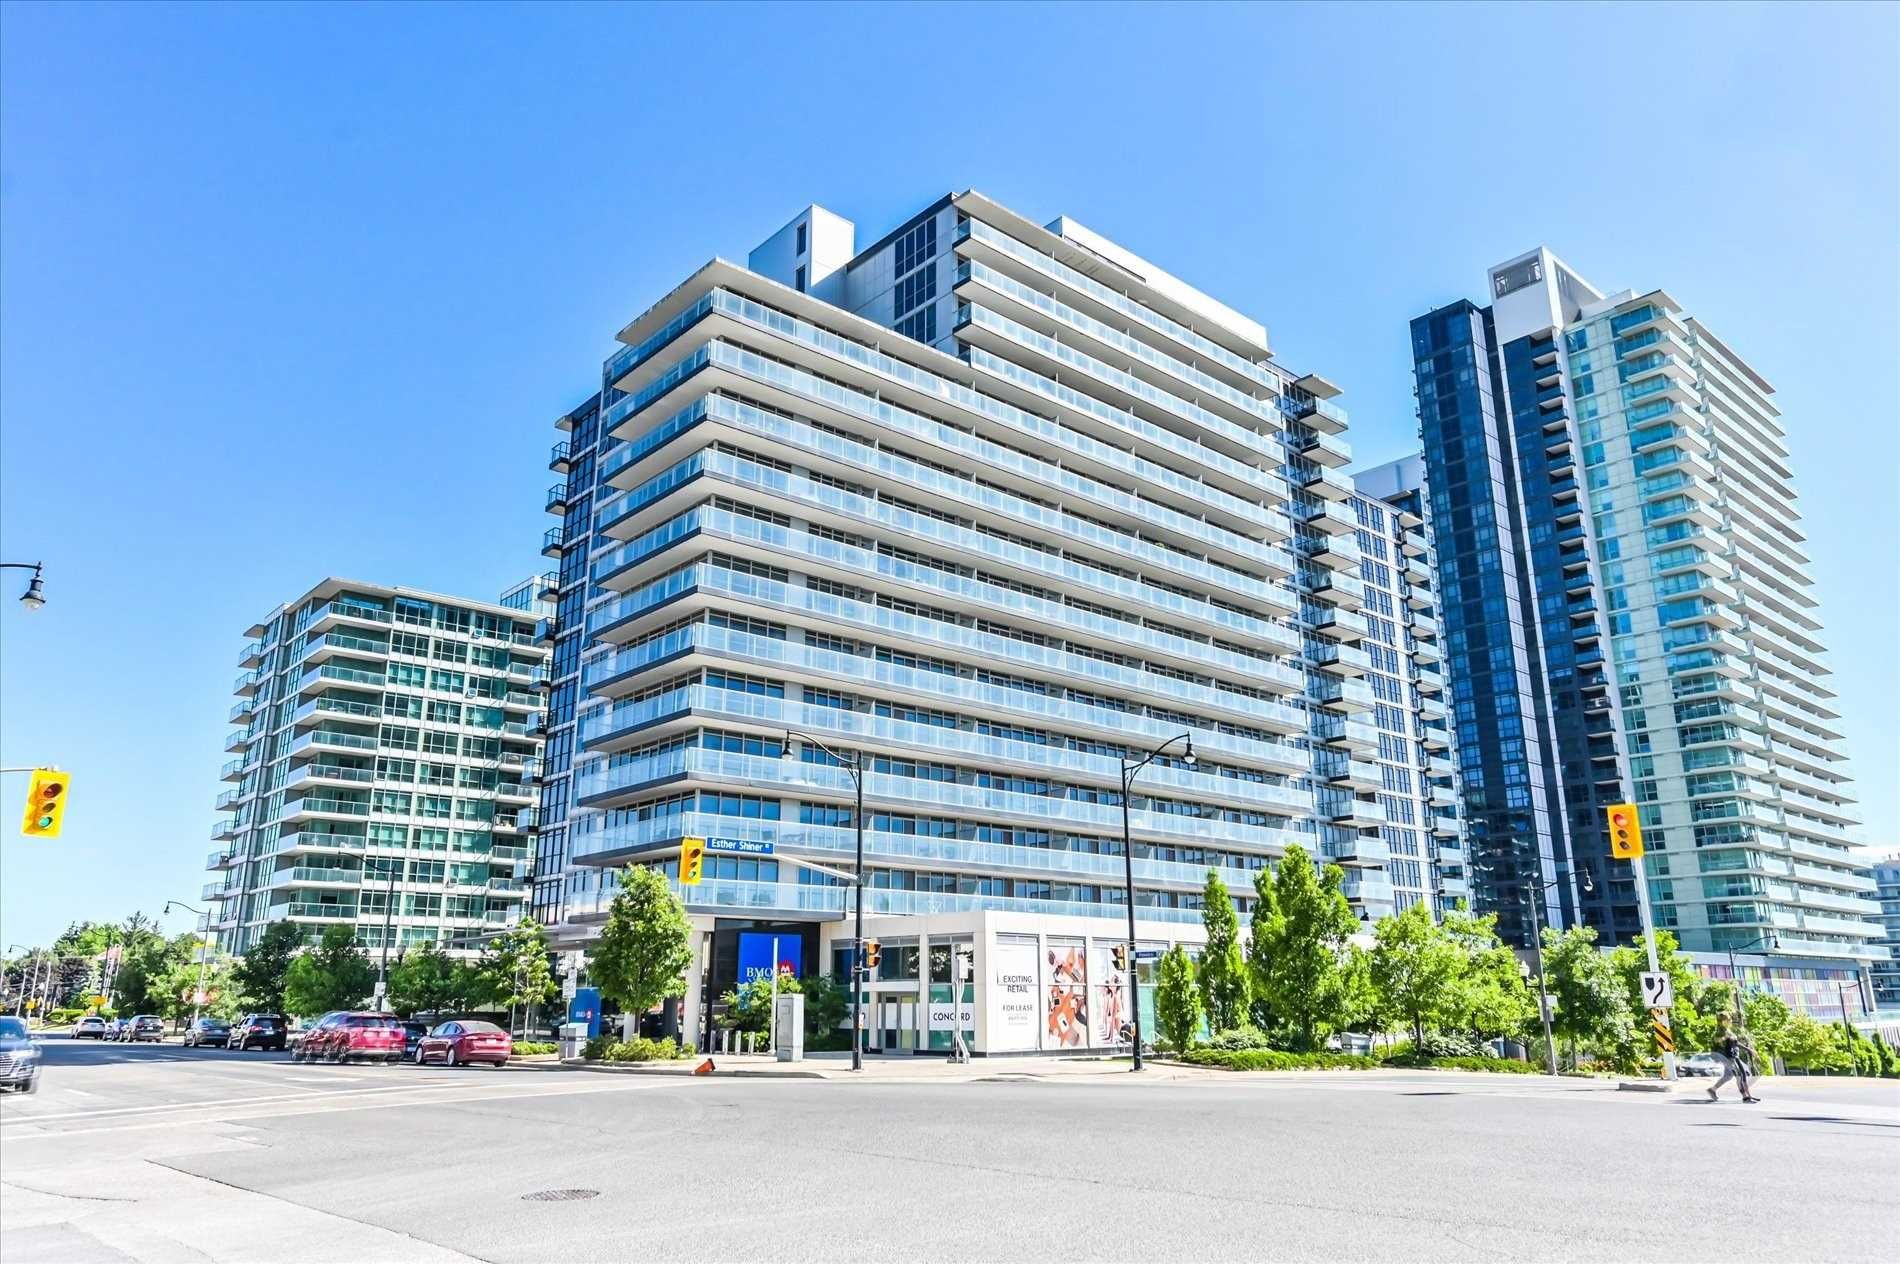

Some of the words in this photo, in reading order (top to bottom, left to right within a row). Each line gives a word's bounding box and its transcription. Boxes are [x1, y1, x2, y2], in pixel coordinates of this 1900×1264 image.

[711, 838, 736, 849] Esther
[738, 841, 763, 852] Shiner
[746, 967, 773, 978] BMO
[1003, 975, 1033, 984] EXCITING
[1007, 984, 1029, 993] RETAIL
[1002, 1004, 1015, 1012] FOR
[1015, 1004, 1033, 1012] LEASE
[933, 1012, 971, 1021] CONCRD
